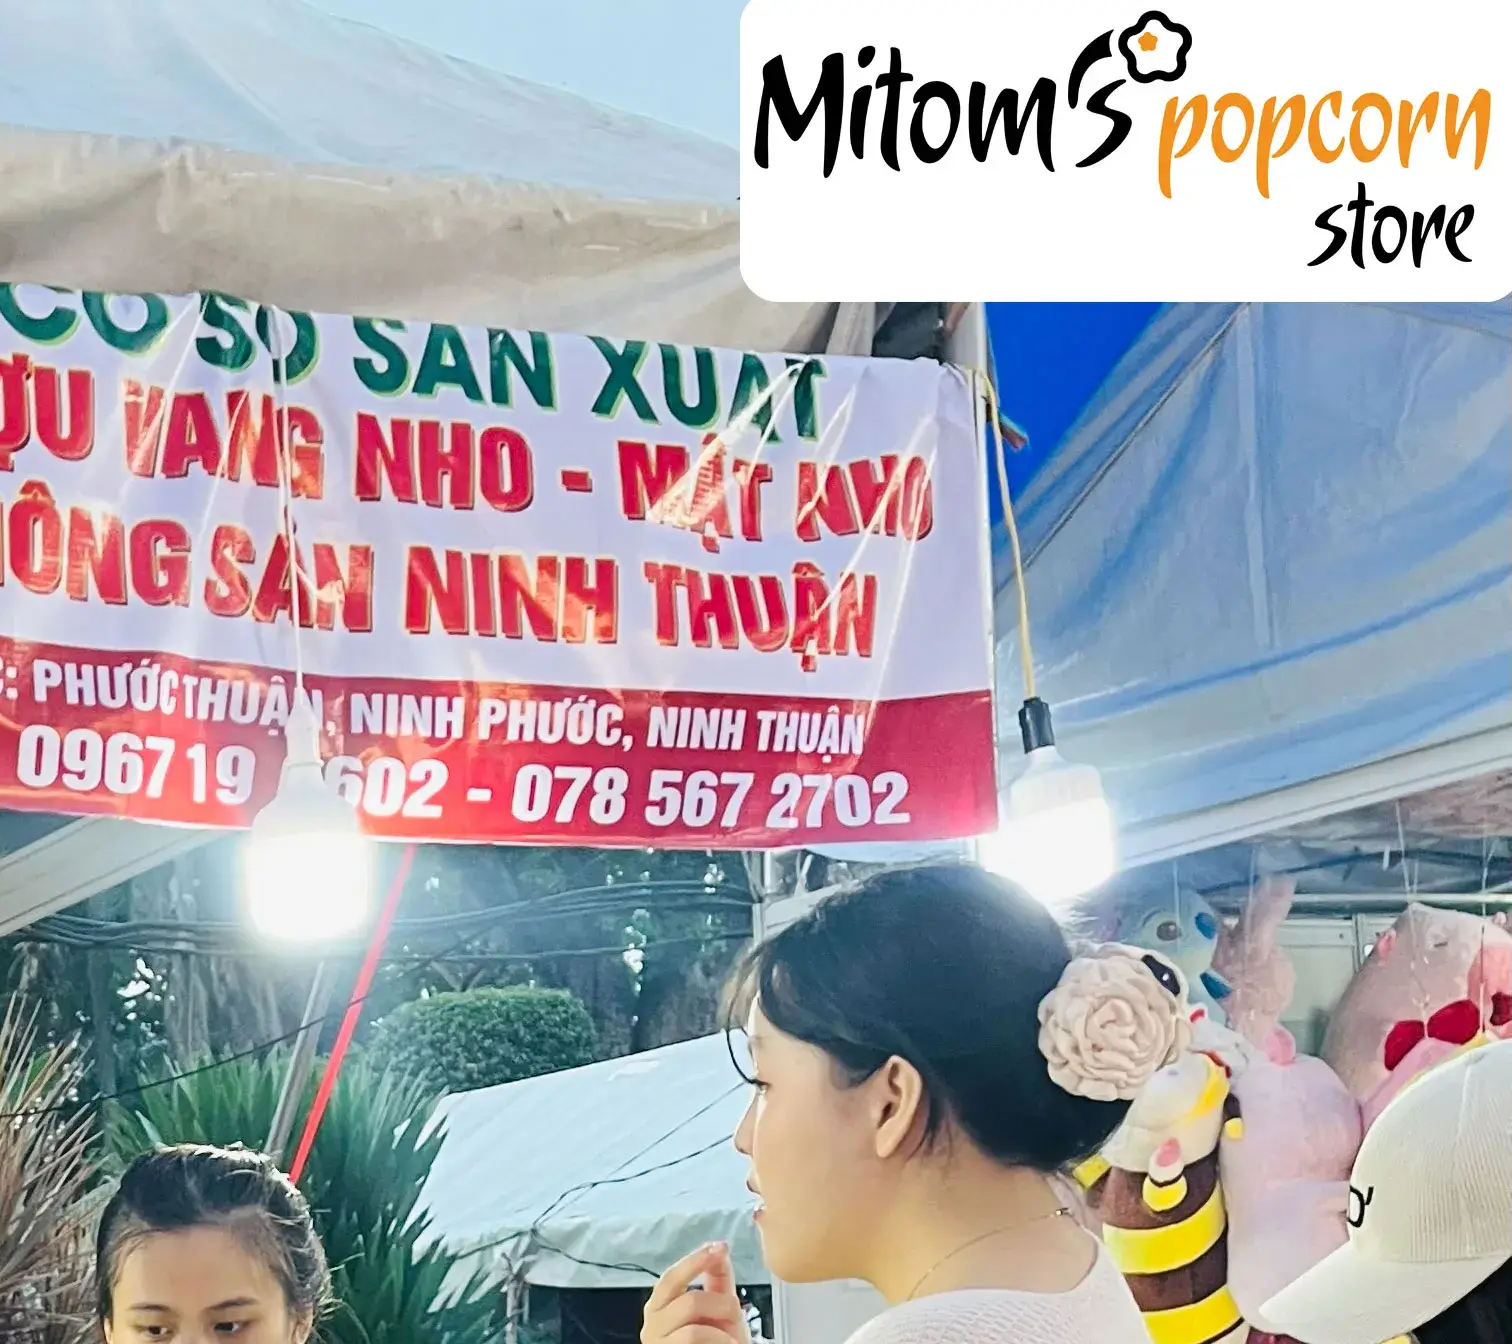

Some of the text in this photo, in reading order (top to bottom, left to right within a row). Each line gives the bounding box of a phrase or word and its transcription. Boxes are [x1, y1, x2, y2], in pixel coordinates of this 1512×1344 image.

[125, 380, 324, 499] VANG
[355, 412, 534, 511] NHO
[796, 455, 934, 542] NHO
[204, 506, 374, 632] SẢN
[405, 545, 618, 644] NINH
[644, 561, 876, 672] THUẬN
[351, 693, 463, 740] NINH
[478, 693, 633, 752] PHƯỚC,
[647, 706, 743, 750] NINH
[757, 705, 864, 758] THUẬN
[324, 755, 447, 818] 602
[511, 765, 626, 825] 078
[644, 771, 755, 828] 567
[765, 771, 910, 829] 2702
